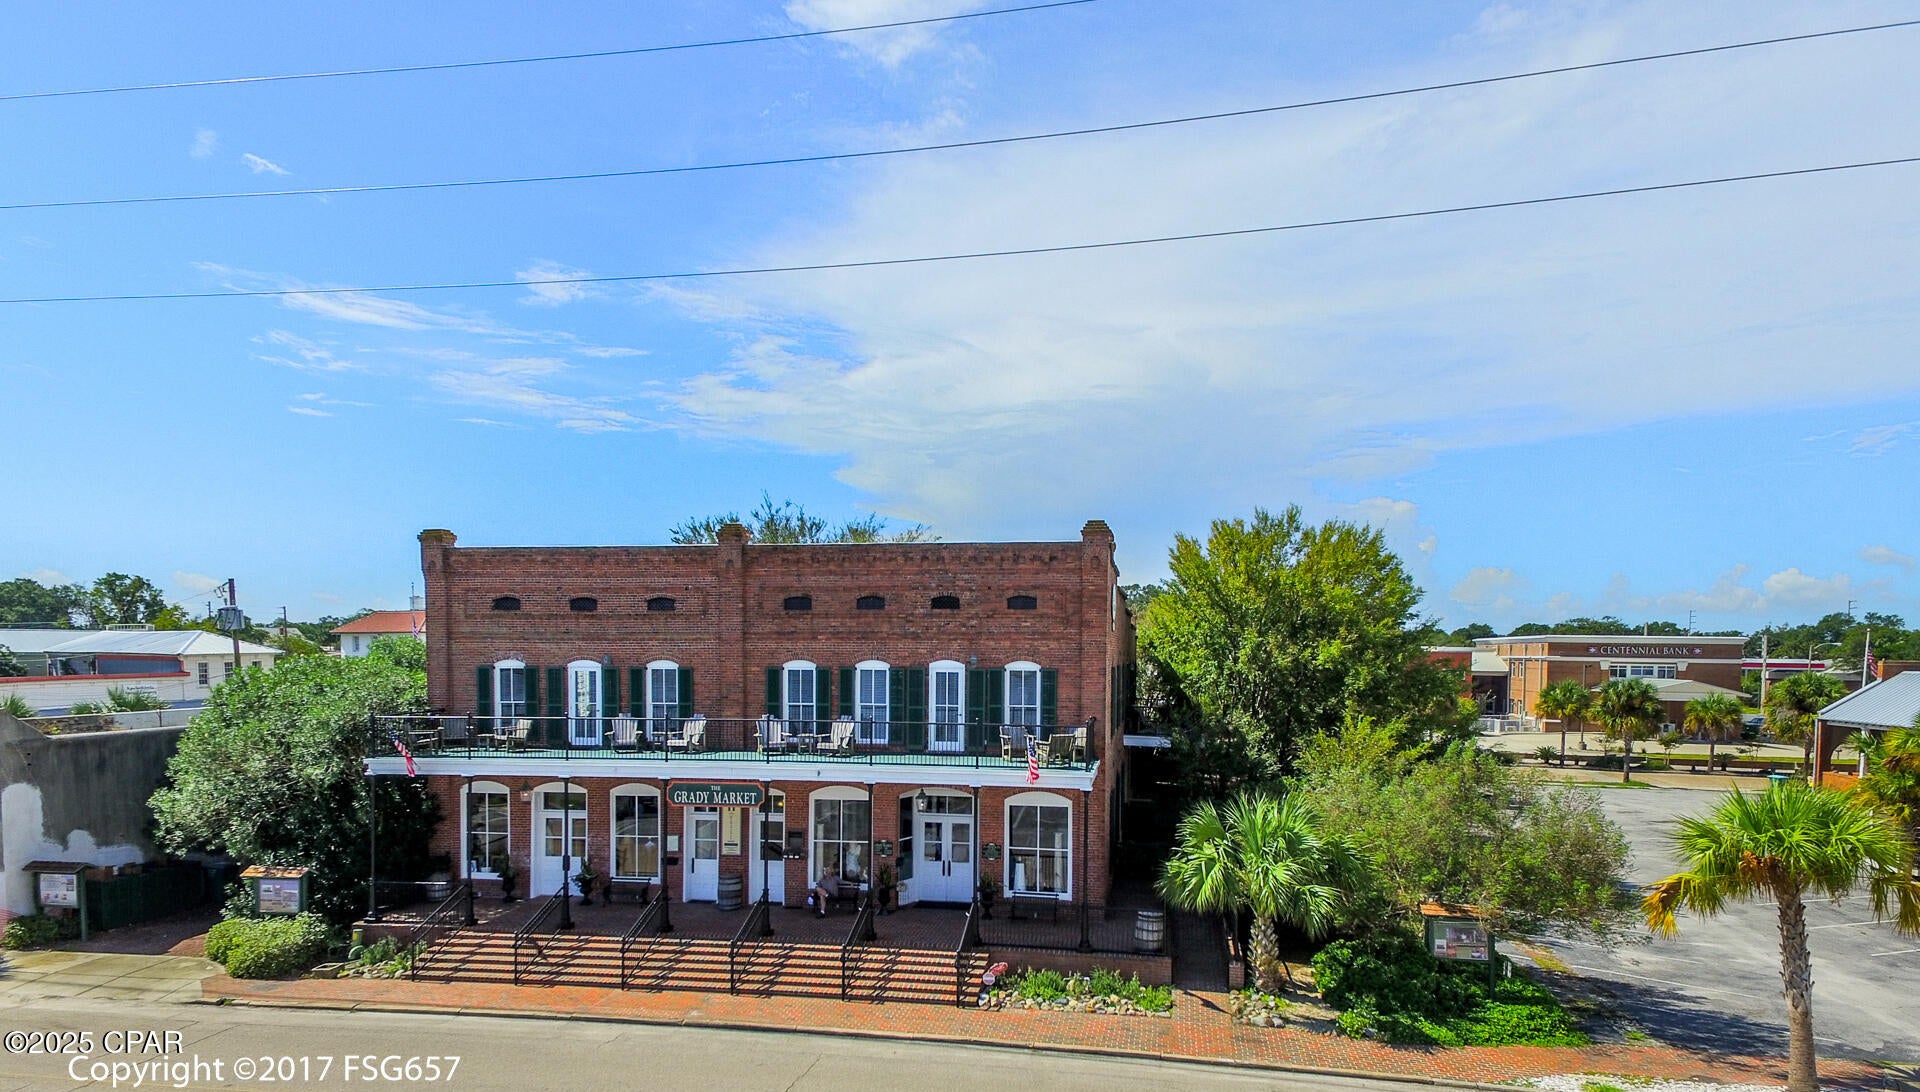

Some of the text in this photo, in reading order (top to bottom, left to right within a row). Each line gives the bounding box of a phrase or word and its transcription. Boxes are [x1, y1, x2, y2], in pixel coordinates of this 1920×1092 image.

[1600, 646, 1689, 656] CENTENNIAL BANK
[674, 790, 757, 805] GRADY MARKET
